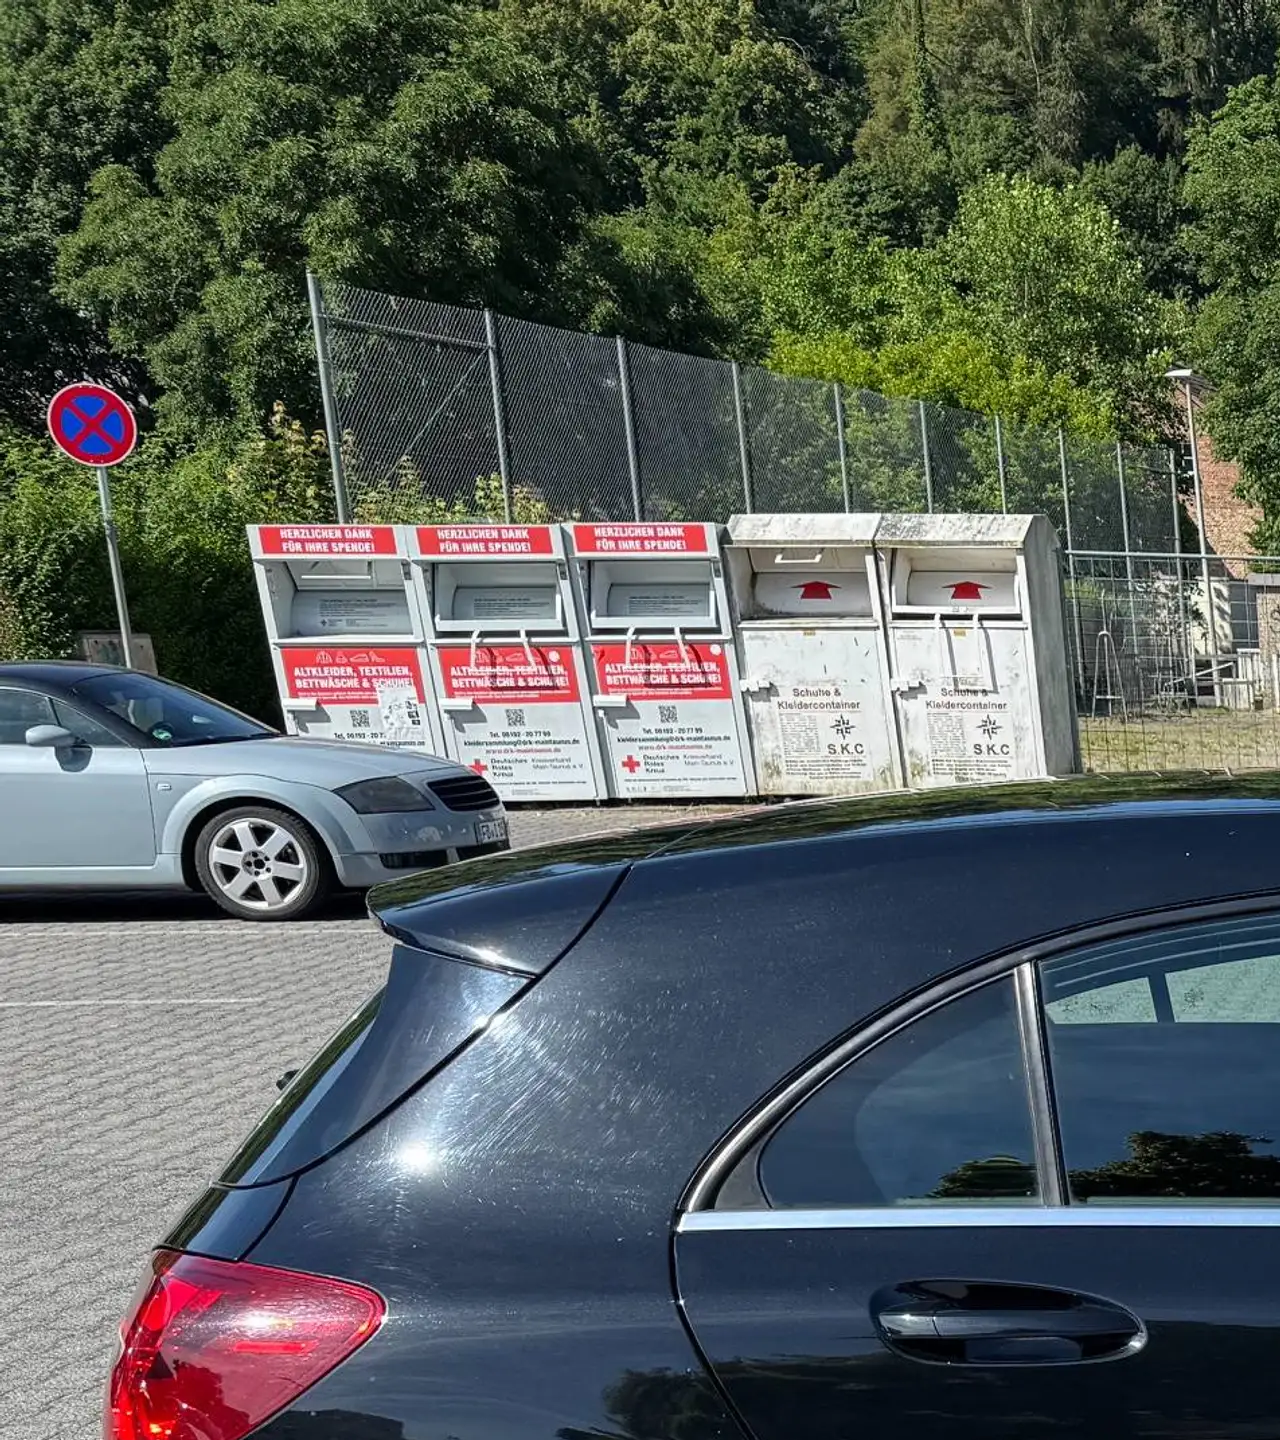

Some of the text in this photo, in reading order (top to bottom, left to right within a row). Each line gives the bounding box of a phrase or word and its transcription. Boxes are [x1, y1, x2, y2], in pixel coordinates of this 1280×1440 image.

[280, 528, 373, 539] HERZLICHEN DANK
[437, 529, 529, 540] HERZLICHEN DANK
[594, 527, 684, 538] HERZLICHEN DANK
[282, 541, 375, 552] FÜR IHRE SPENDE!
[439, 541, 531, 553] FÜR IHRE SPENDE!
[596, 539, 687, 551] FÜR IHRE SPENDE!
[294, 666, 413, 677] ALTKLEIDER, TEXTILIEN,
[295, 678, 360, 689] BETTWÄSCHE
[362, 679, 370, 688] &
[518, 677, 526, 686] &
[671, 676, 679, 684] &
[793, 688, 841, 697] Schuhe &
[941, 688, 979, 697] Schuhe
[777, 700, 860, 710] Kleidercontainer
[926, 700, 1007, 710] Kleidercontainer
